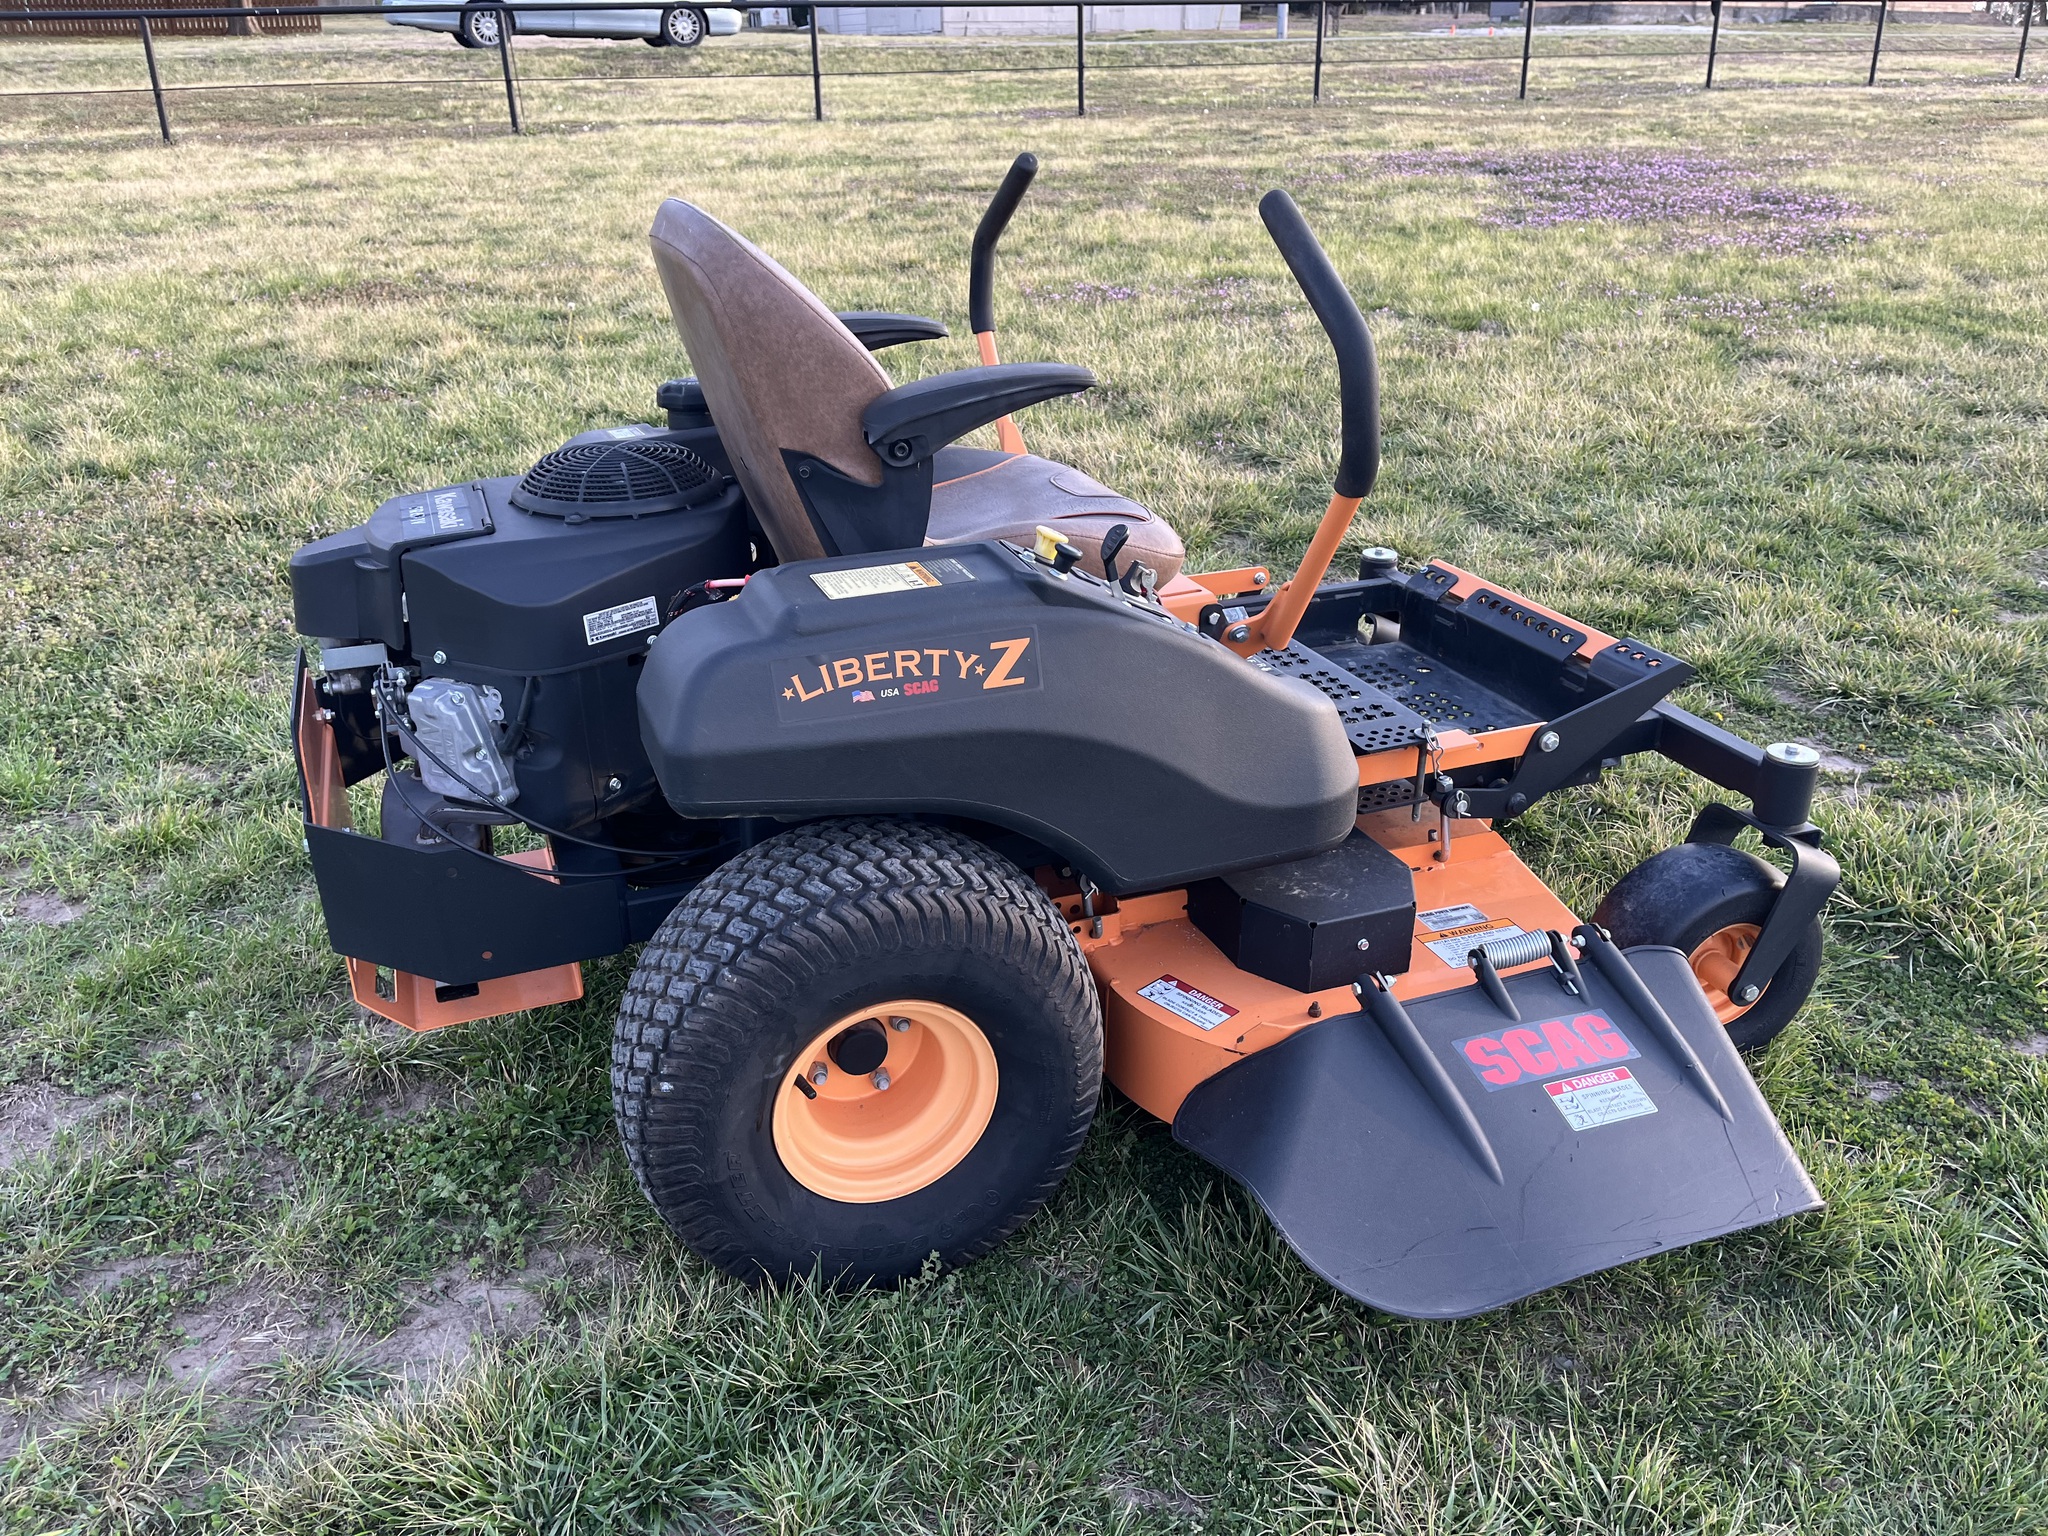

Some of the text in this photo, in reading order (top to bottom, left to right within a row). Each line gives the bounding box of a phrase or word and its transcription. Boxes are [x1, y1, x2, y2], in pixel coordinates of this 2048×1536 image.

[434, 492, 464, 529] Kawasaki
[790, 637, 1031, 702] LIBERTY Z
[880, 679, 939, 698] USA SCAG
[1448, 923, 1495, 936] WARNING
[1176, 991, 1224, 1018] SPINNING BLADES
[1188, 989, 1224, 1010] DANGER
[1464, 1014, 1629, 1085] SCAG
[1572, 1071, 1620, 1090] DANGER
[1581, 1083, 1634, 1101] SPINNING BLADES
